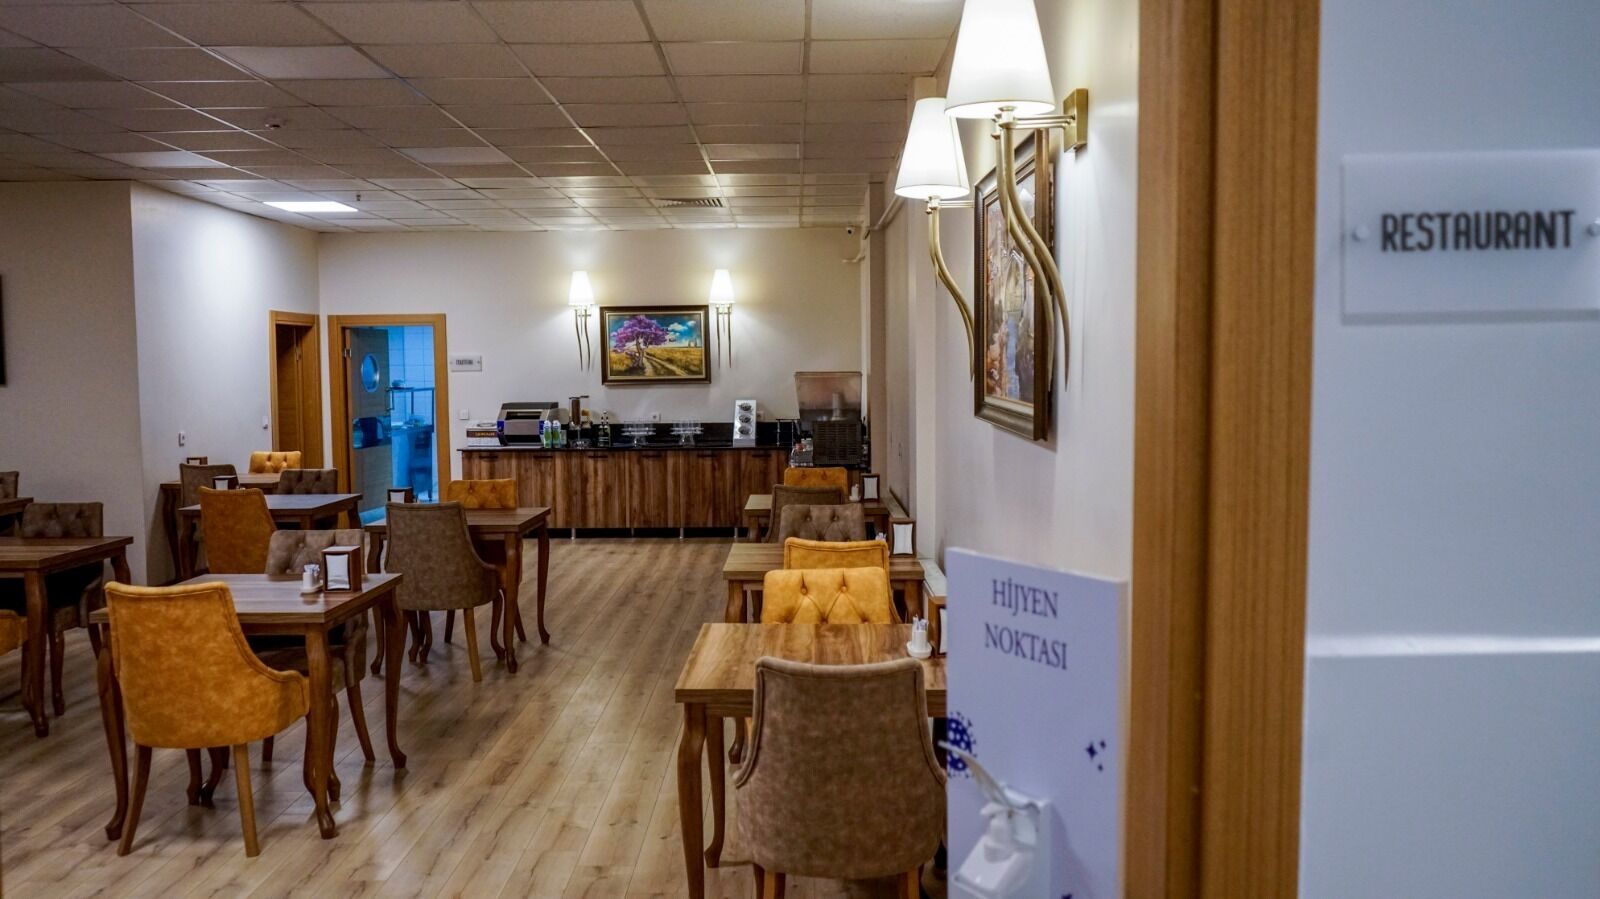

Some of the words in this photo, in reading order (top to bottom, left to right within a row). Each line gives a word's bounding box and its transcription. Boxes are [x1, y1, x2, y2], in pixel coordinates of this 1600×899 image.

[1381, 209, 1575, 252] RESTAURANT
[992, 577, 1059, 618] HİJYEN
[985, 622, 1068, 670] NOKTASI
